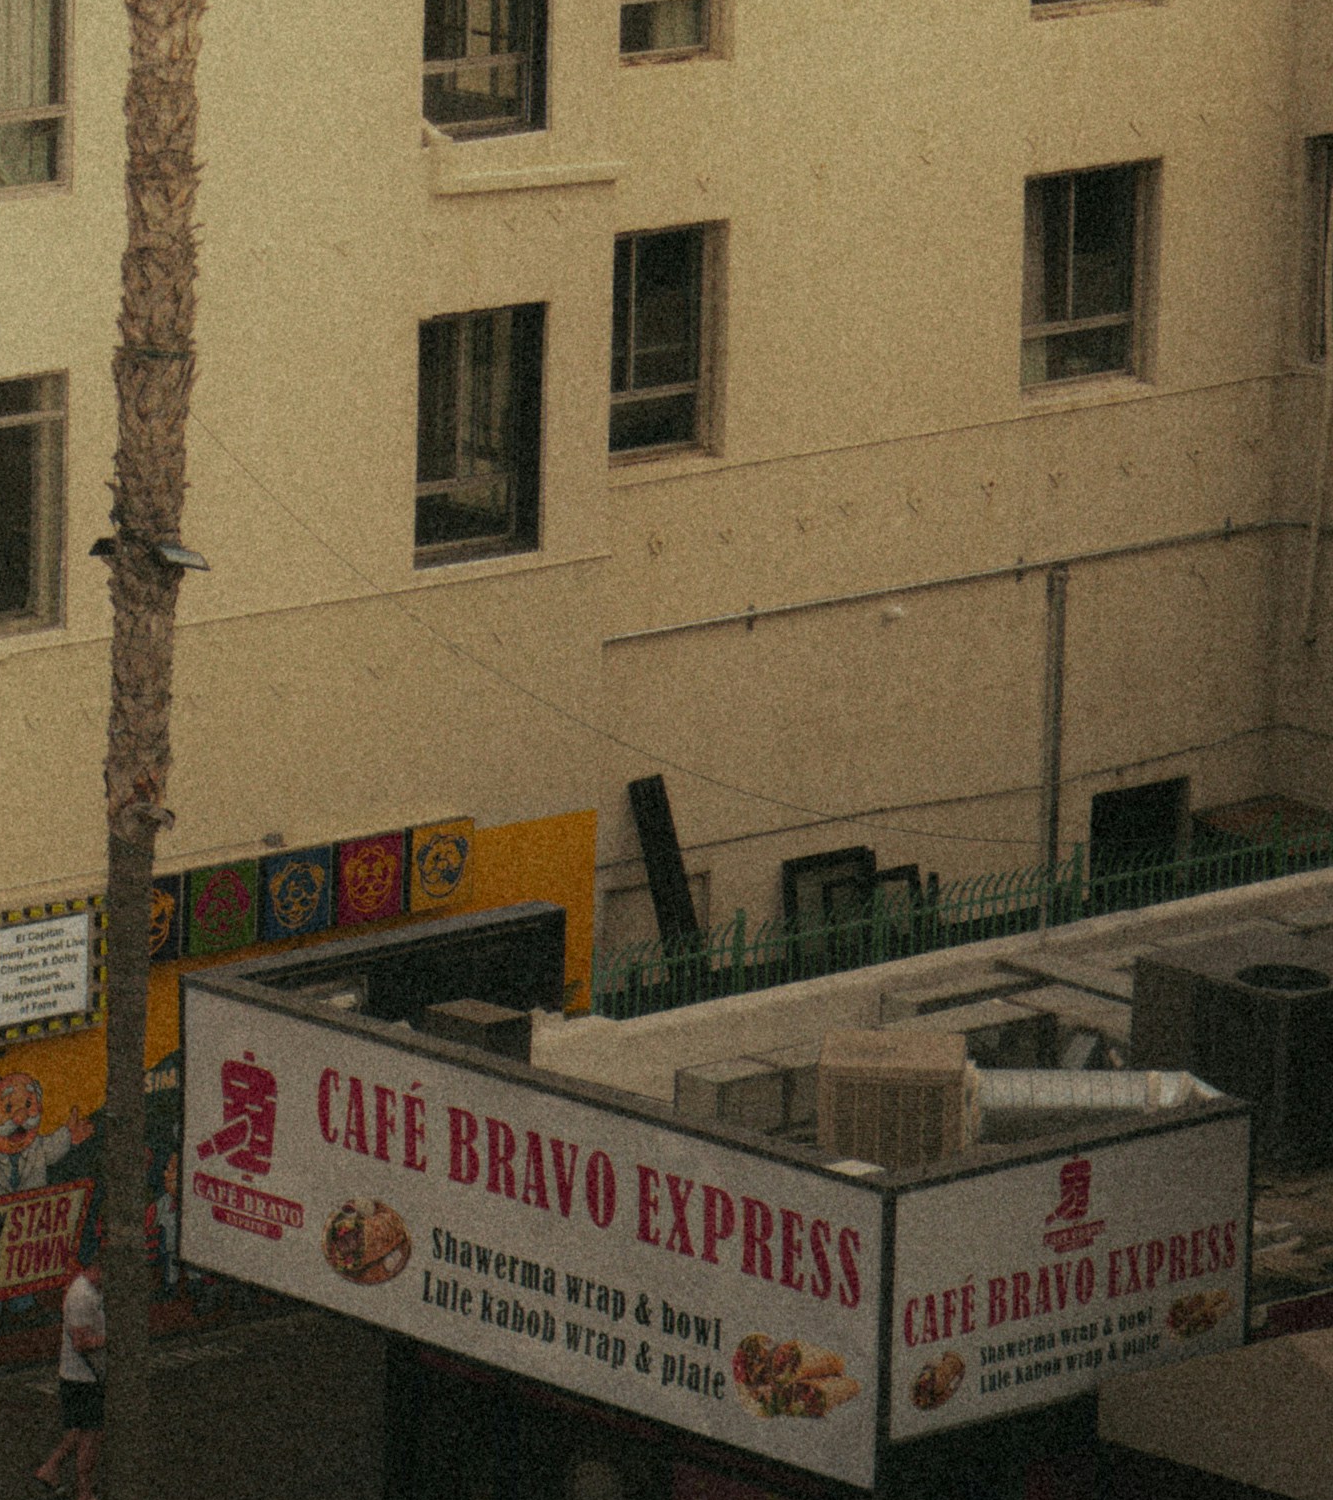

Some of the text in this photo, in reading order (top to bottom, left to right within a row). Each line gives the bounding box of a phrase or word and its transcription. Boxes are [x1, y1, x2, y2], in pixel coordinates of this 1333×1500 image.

[194, 1177, 303, 1228] CAFÉ BRAVO
[317, 1067, 863, 1310] CAFÉ BRAVO EXPRESS
[8, 1196, 69, 1243] STAR
[3, 1234, 72, 1278] TOWN
[431, 1226, 723, 1351] Shawerma wrap & bowl
[903, 1219, 1238, 1347] CAFÉ BRAVO EXPRESS
[421, 1270, 726, 1401] Lule kabob wrap & plate
[1060, 1319, 1098, 1346] wrap
[1066, 1346, 1103, 1372] wrap
